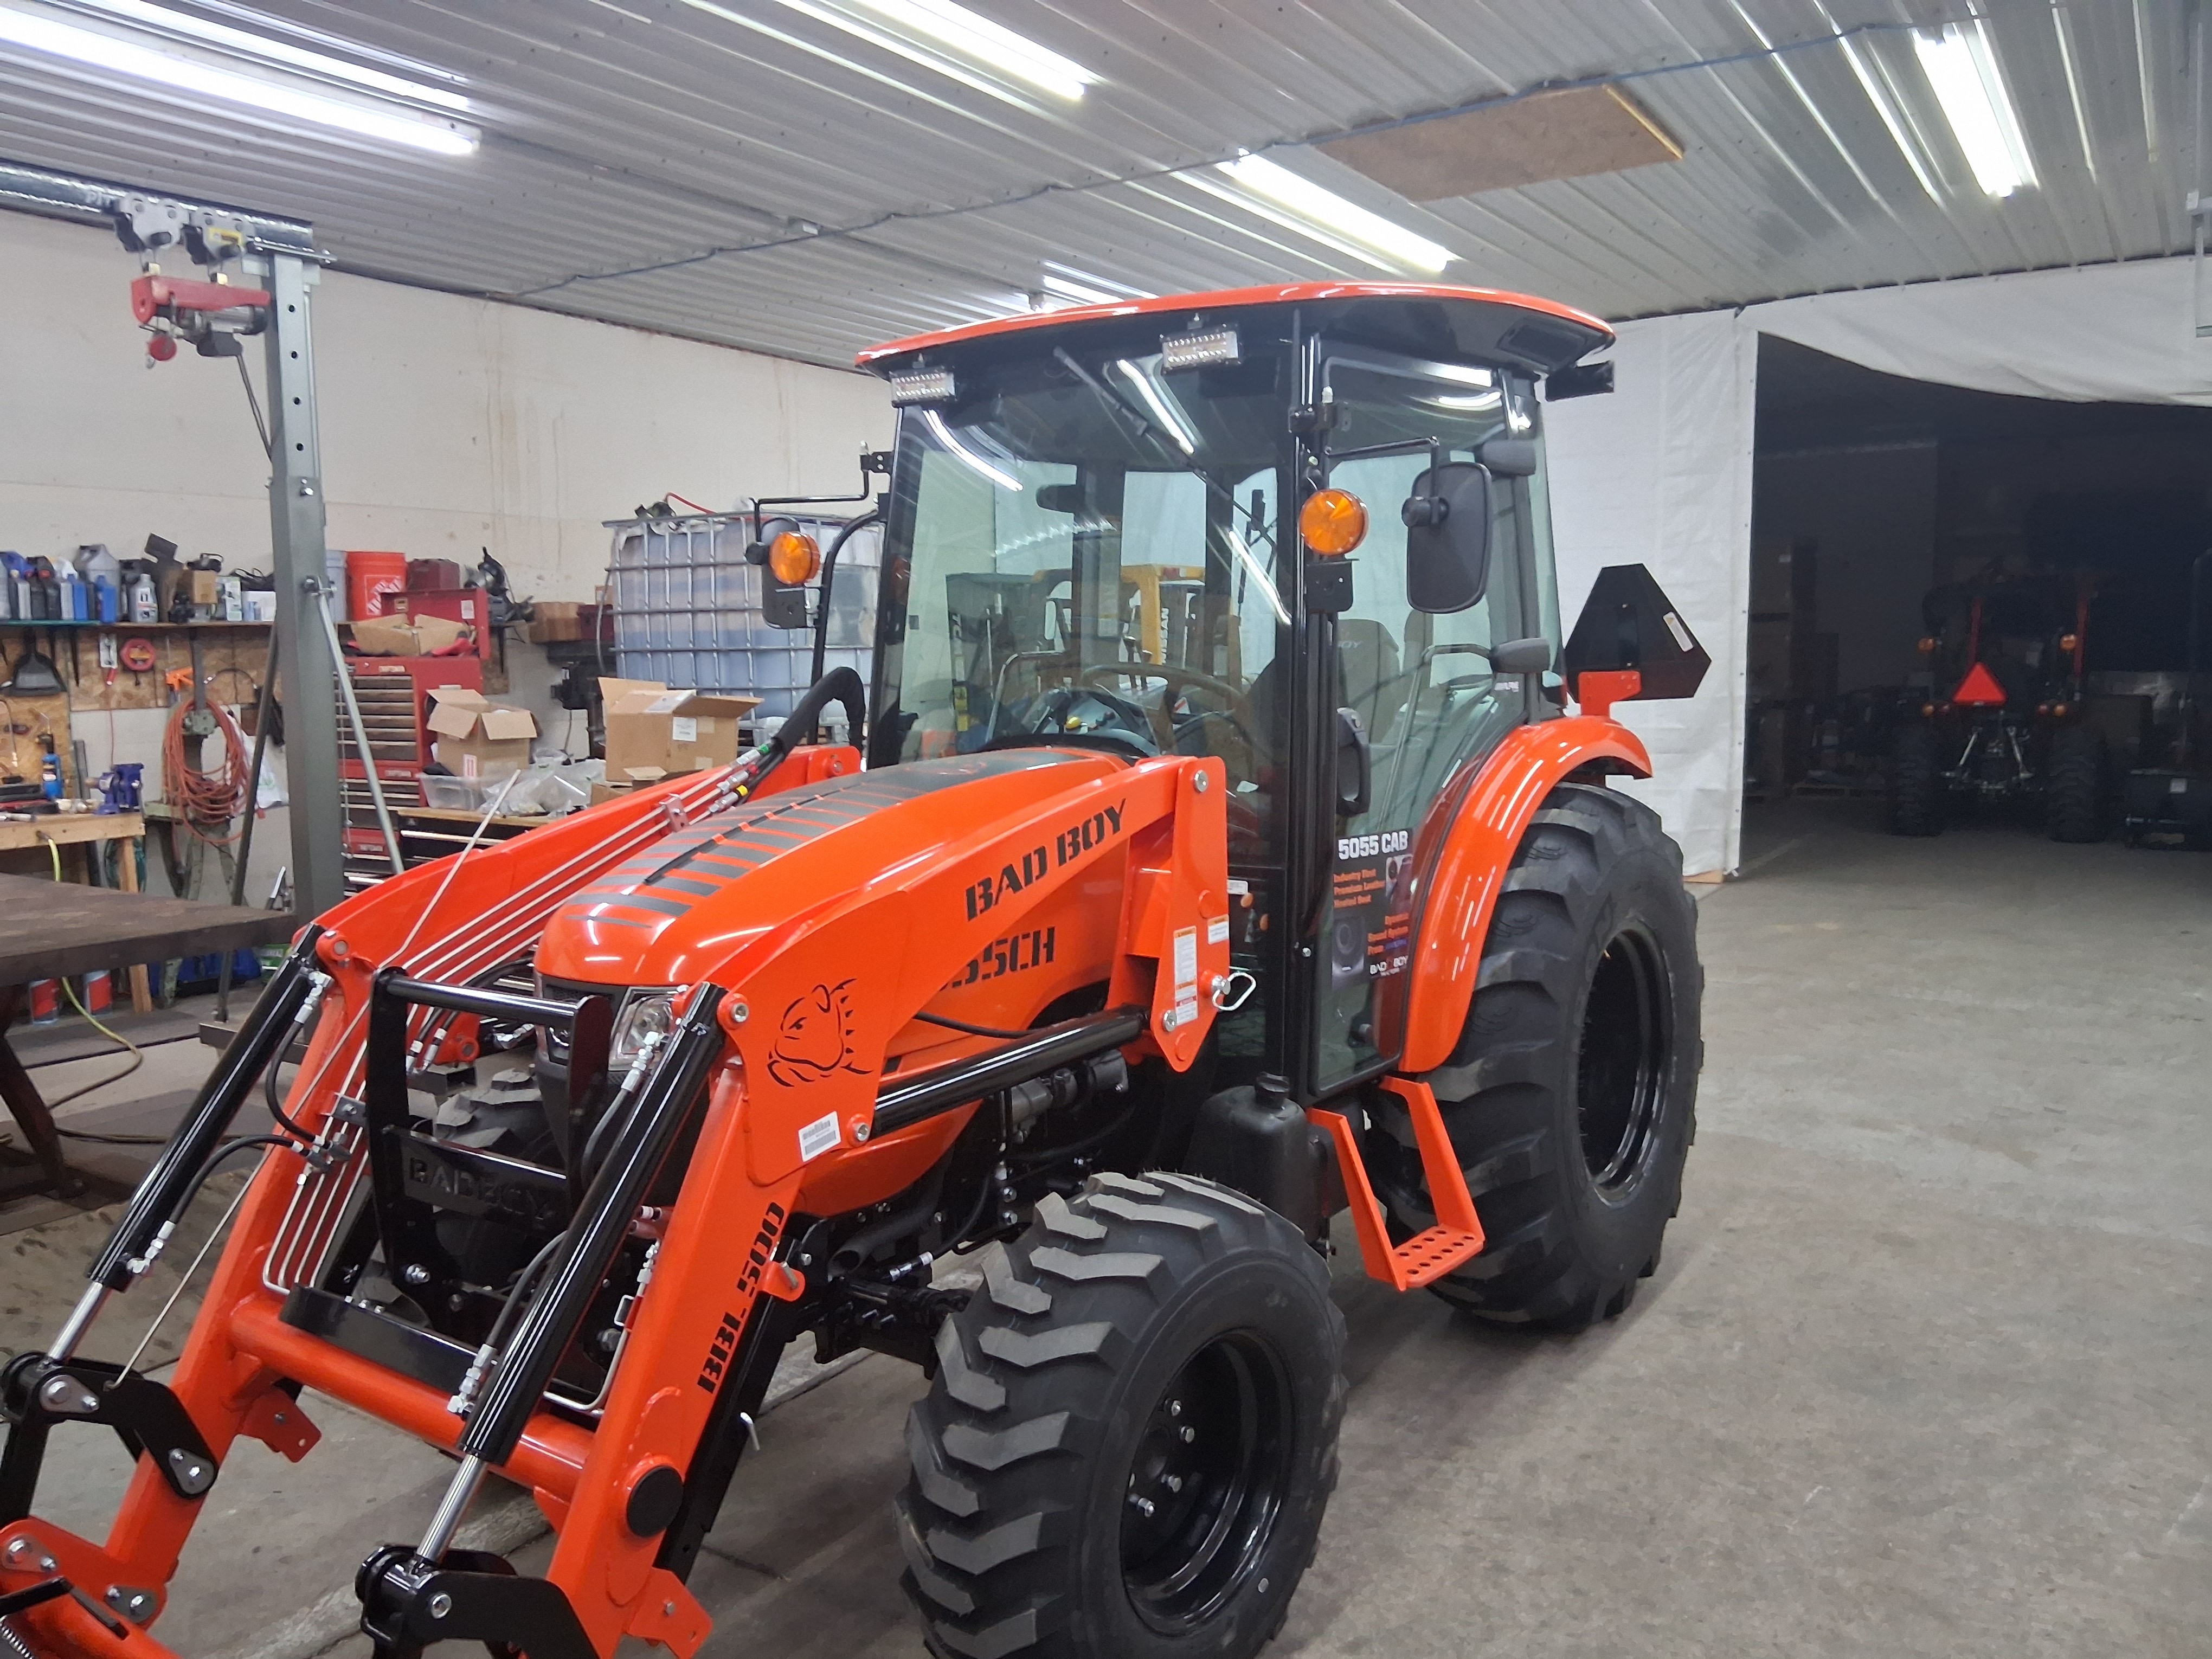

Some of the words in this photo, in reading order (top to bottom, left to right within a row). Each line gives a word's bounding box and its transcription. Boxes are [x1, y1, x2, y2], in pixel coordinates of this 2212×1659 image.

[965, 845, 1048, 922] BAD
[1056, 798, 1127, 867] BOY
[1338, 834, 1379, 860] 5055
[1381, 830, 1409, 854] CAB
[697, 1307, 747, 1394] BBL
[736, 1201, 785, 1298] 500
